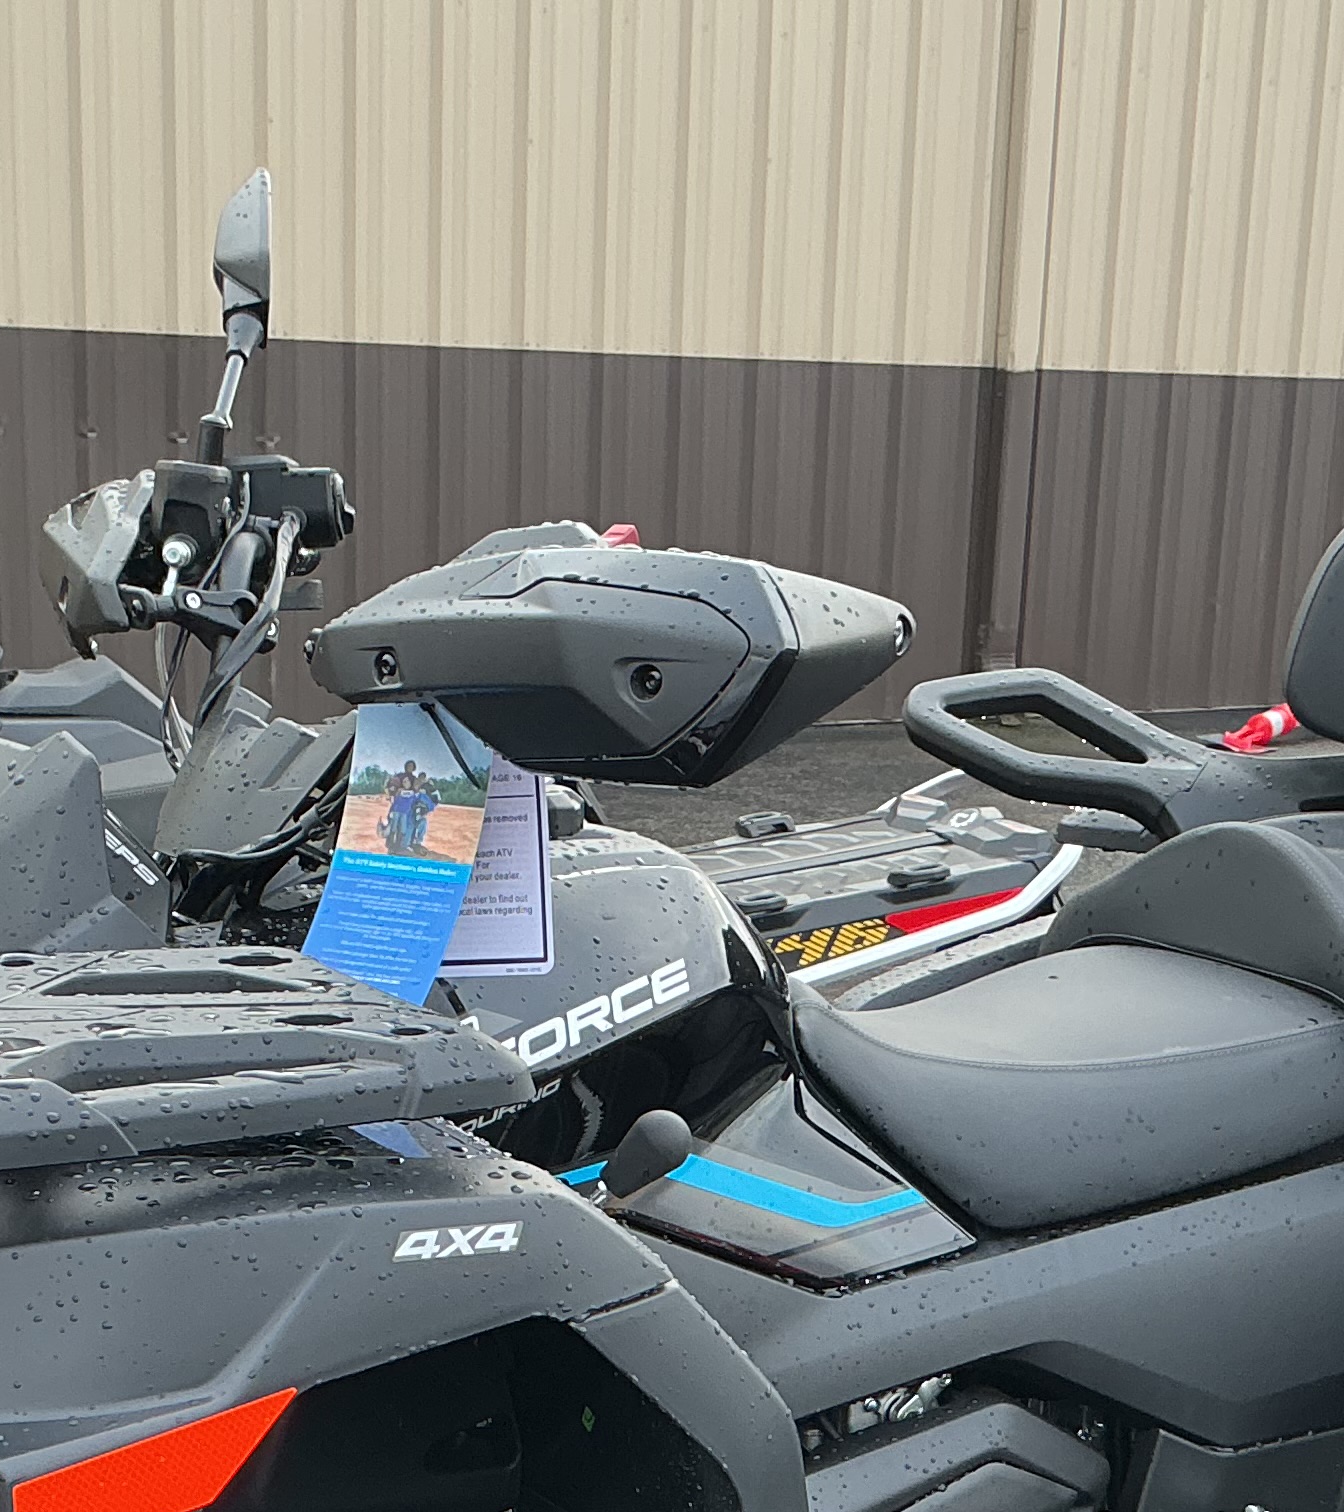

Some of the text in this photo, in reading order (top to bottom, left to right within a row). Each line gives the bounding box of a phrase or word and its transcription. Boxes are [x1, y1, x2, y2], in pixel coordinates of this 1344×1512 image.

[493, 813, 528, 823] removed
[105, 828, 159, 886] EPS
[496, 848, 513, 858] ATV
[476, 861, 490, 870] For
[475, 873, 492, 883] your
[463, 894, 528, 905] dealer to find out
[494, 905, 533, 917] regarding
[766, 918, 891, 966] 46
[394, 1223, 519, 1260] 4X4
